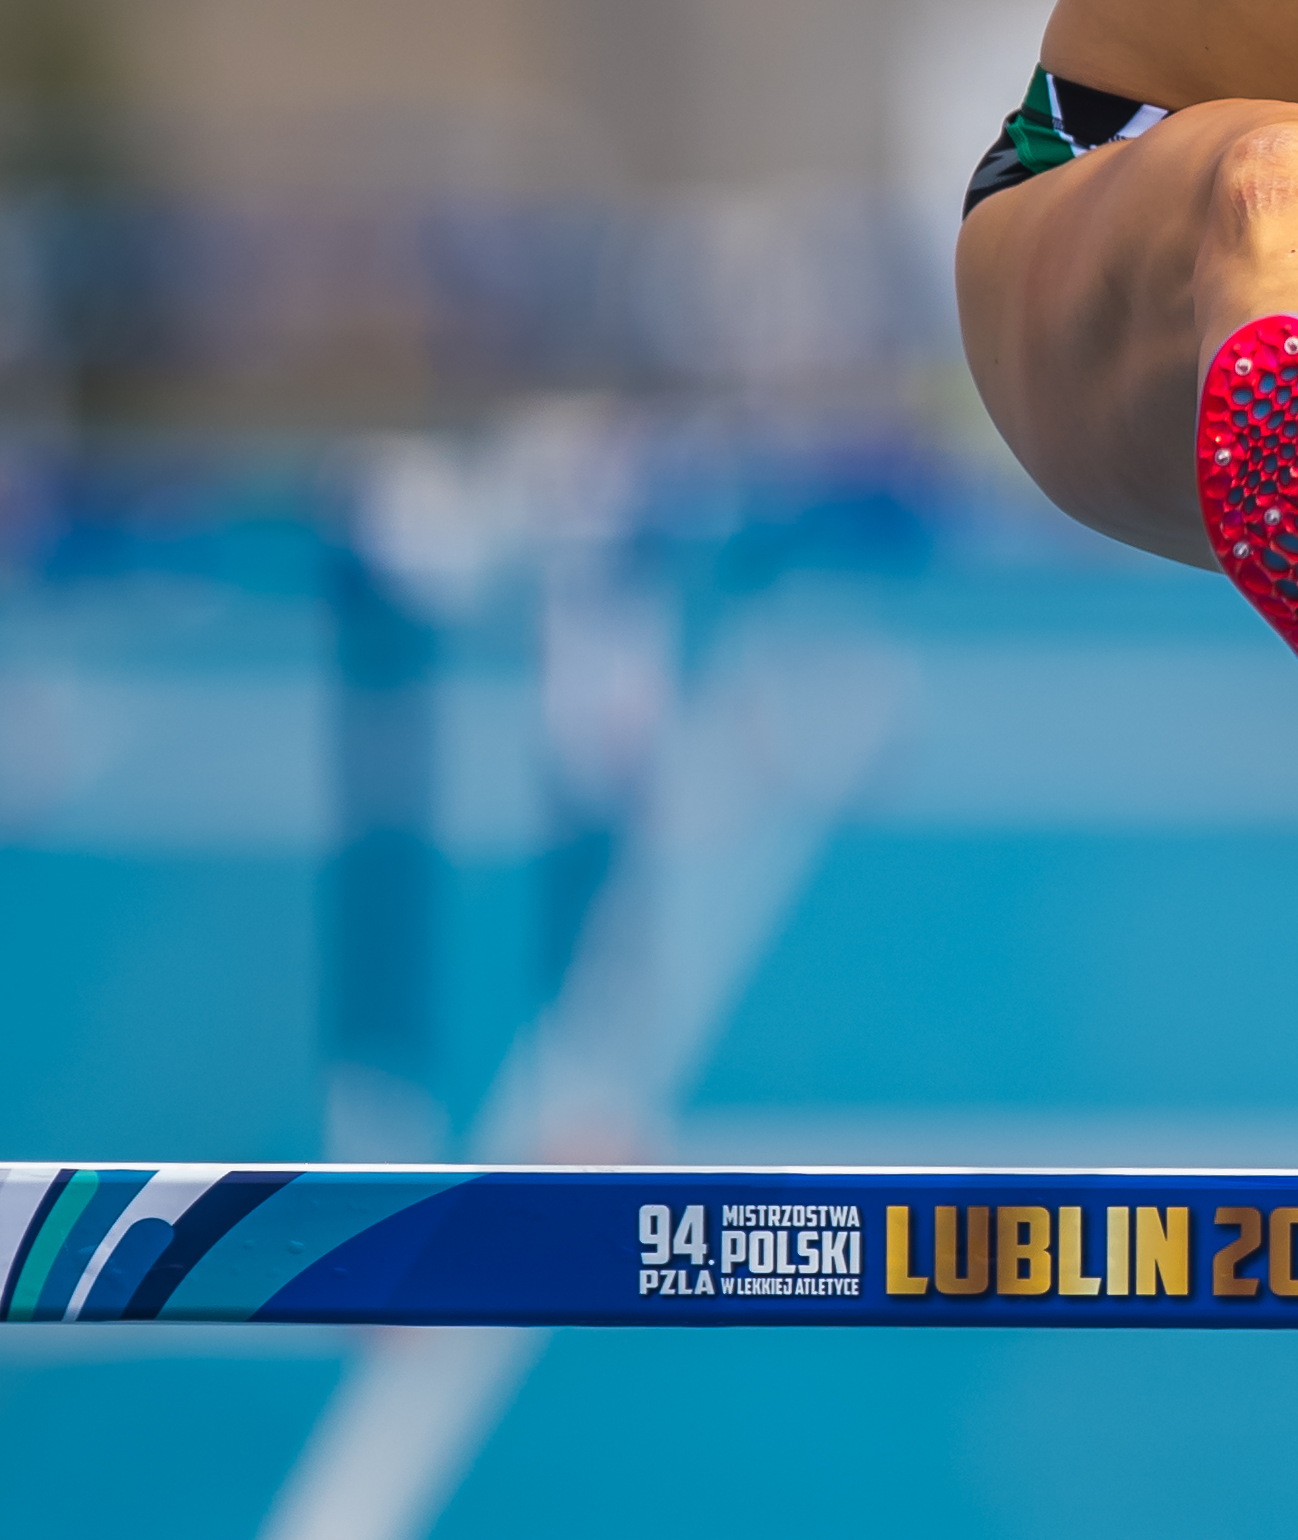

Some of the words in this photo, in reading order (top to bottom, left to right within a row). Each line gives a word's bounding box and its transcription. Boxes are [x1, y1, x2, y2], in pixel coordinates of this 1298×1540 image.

[722, 1204, 861, 1228] MISTRZOSTWA
[638, 1204, 715, 1266] 94.
[721, 1230, 861, 1275] POLSKI
[886, 1206, 1189, 1295] LUBLIN
[638, 1269, 716, 1295] PZLA
[721, 1277, 736, 1296] W
[737, 1277, 793, 1296] LEKKIEJ
[794, 1277, 860, 1296] ATLETYCE
